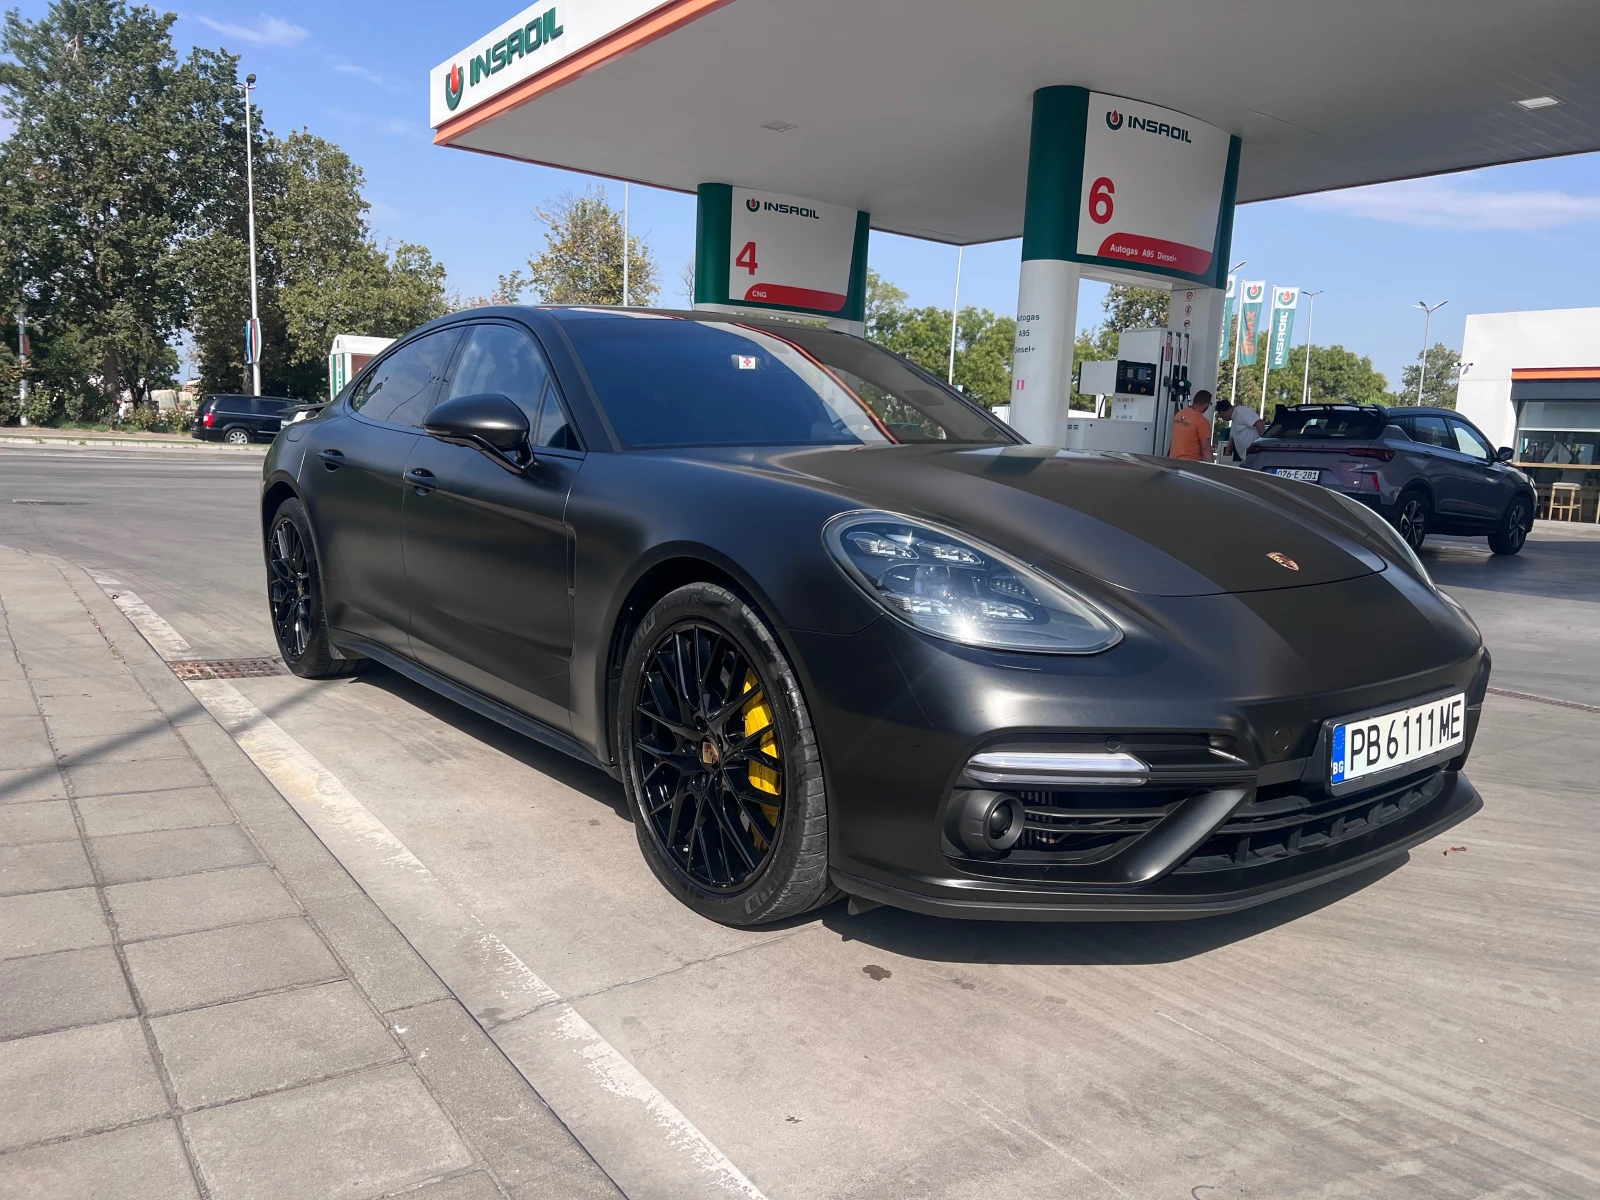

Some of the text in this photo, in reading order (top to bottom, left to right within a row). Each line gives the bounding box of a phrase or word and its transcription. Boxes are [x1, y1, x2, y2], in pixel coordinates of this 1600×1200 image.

[470, 7, 564, 87] INSAOIL
[1127, 115, 1192, 144] INSAOIL
[763, 201, 820, 220] INSAOIL
[1088, 177, 1115, 224] 6
[735, 241, 758, 276] 4
[1109, 243, 1138, 257] Autogas
[1142, 248, 1154, 258] A95
[752, 290, 767, 298] CNG
[1018, 329, 1030, 337] A95
[1274, 311, 1289, 365] INSAOIL
[1332, 761, 1344, 775] BG
